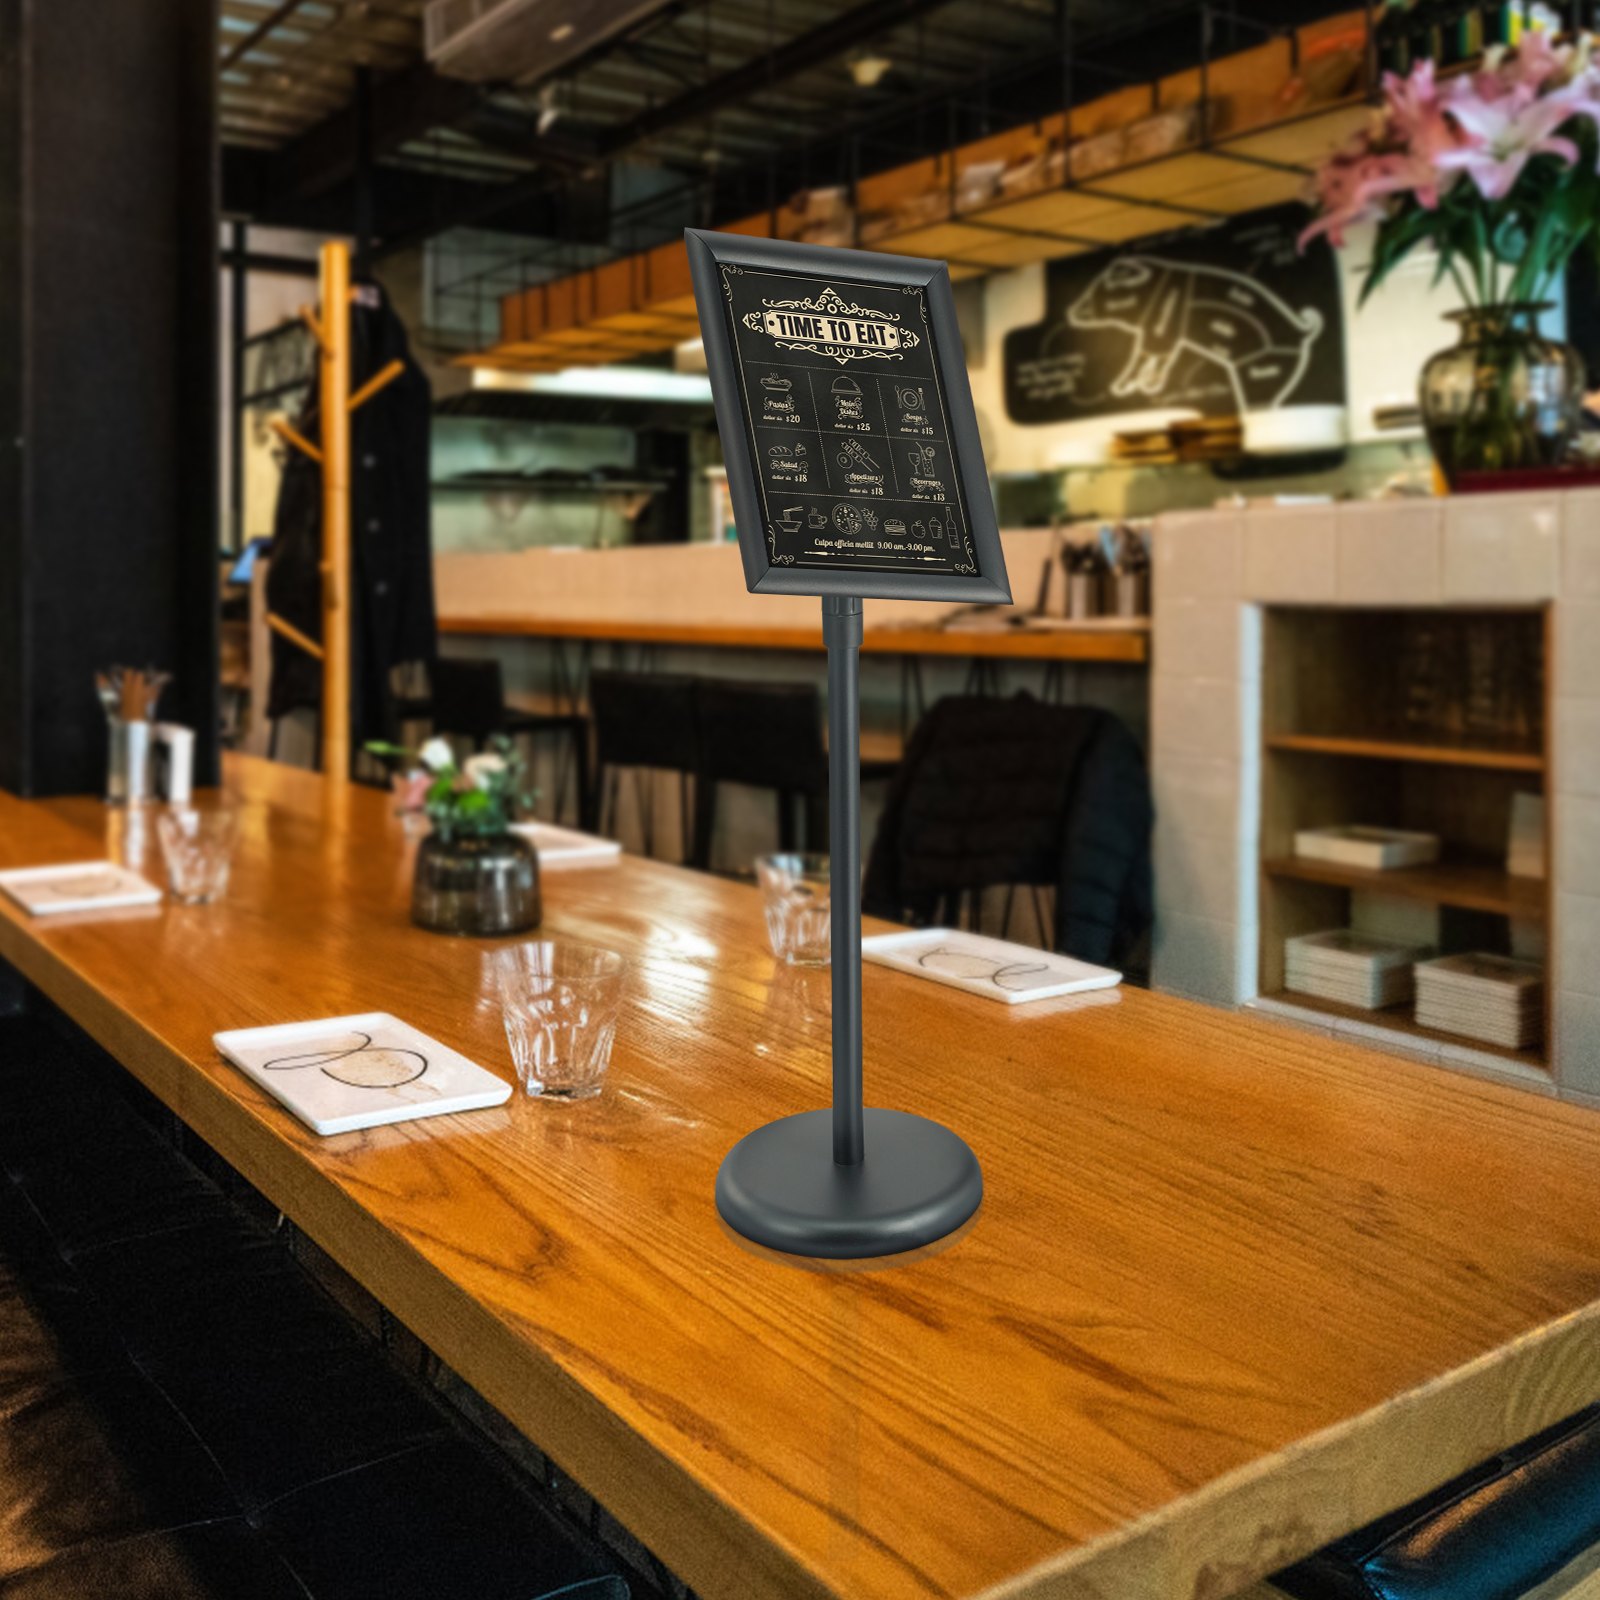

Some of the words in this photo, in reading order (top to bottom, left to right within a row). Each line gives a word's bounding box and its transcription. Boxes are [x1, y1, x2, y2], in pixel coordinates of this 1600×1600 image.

[776, 314, 825, 340] TIME
[827, 319, 851, 342] TO
[855, 322, 887, 346] EAT
[767, 400, 789, 409] Pastas
[786, 414, 801, 424] $20
[905, 412, 922, 423] Soups
[856, 422, 871, 431] $25
[921, 426, 934, 436] $15
[780, 460, 798, 469] Salad
[794, 474, 808, 483] $18
[871, 487, 884, 496] $18
[933, 493, 946, 502] $13
[814, 537, 834, 548] Culpa
[877, 541, 893, 550] 9.00
